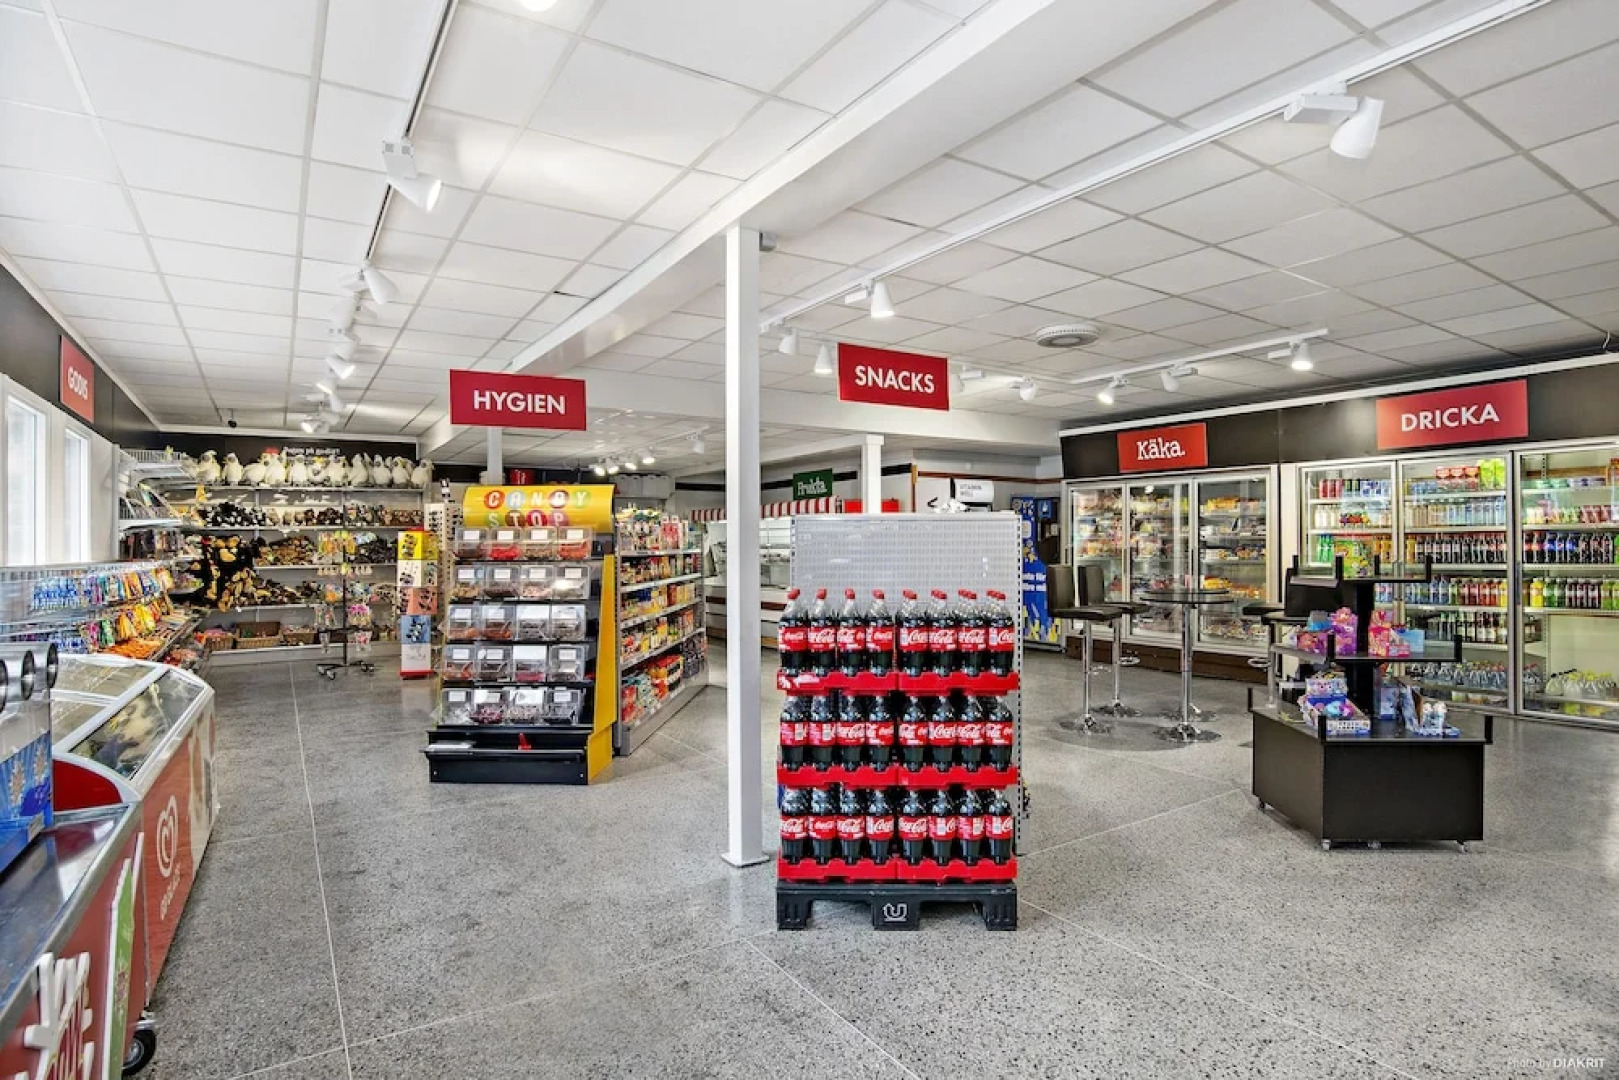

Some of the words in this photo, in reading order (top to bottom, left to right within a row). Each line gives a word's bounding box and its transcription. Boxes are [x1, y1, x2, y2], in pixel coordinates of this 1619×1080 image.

[67, 365, 89, 401] GODIS
[854, 365, 936, 394] SNACKS
[473, 389, 566, 415] HYGIEN
[1401, 402, 1500, 432] DRICKA
